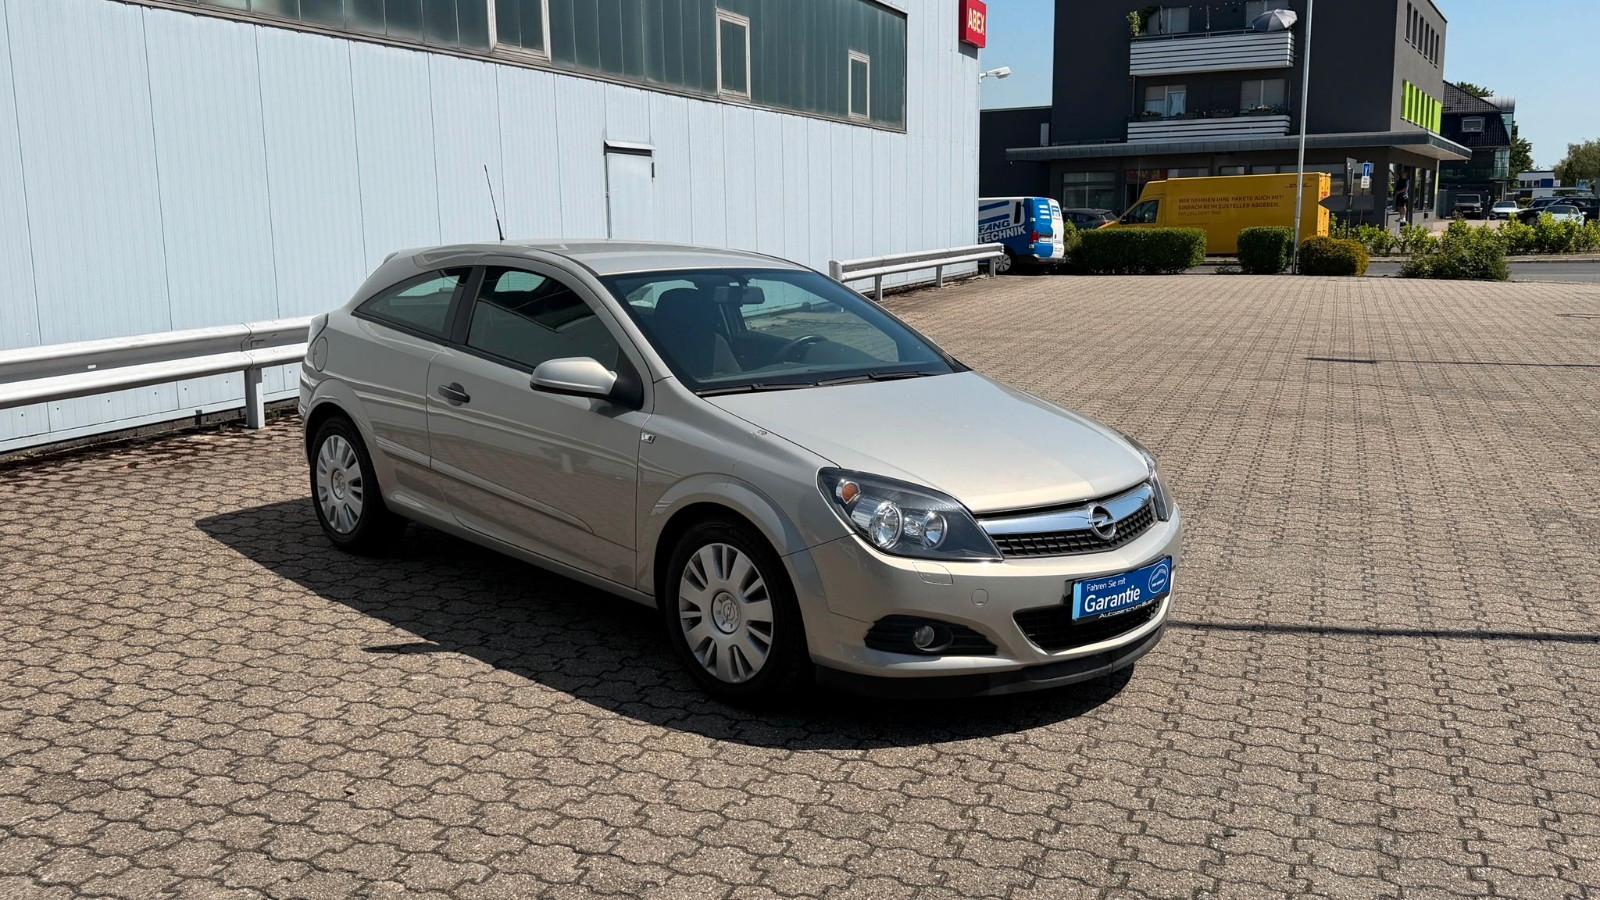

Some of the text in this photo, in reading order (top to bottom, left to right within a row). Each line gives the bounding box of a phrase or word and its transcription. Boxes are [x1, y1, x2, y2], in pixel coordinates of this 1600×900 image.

[968, 8, 985, 34] ABEX
[978, 225, 1027, 243] TECHNIK
[1086, 577, 1126, 592] Fahren Sie mit
[1084, 585, 1141, 612] Garantie
